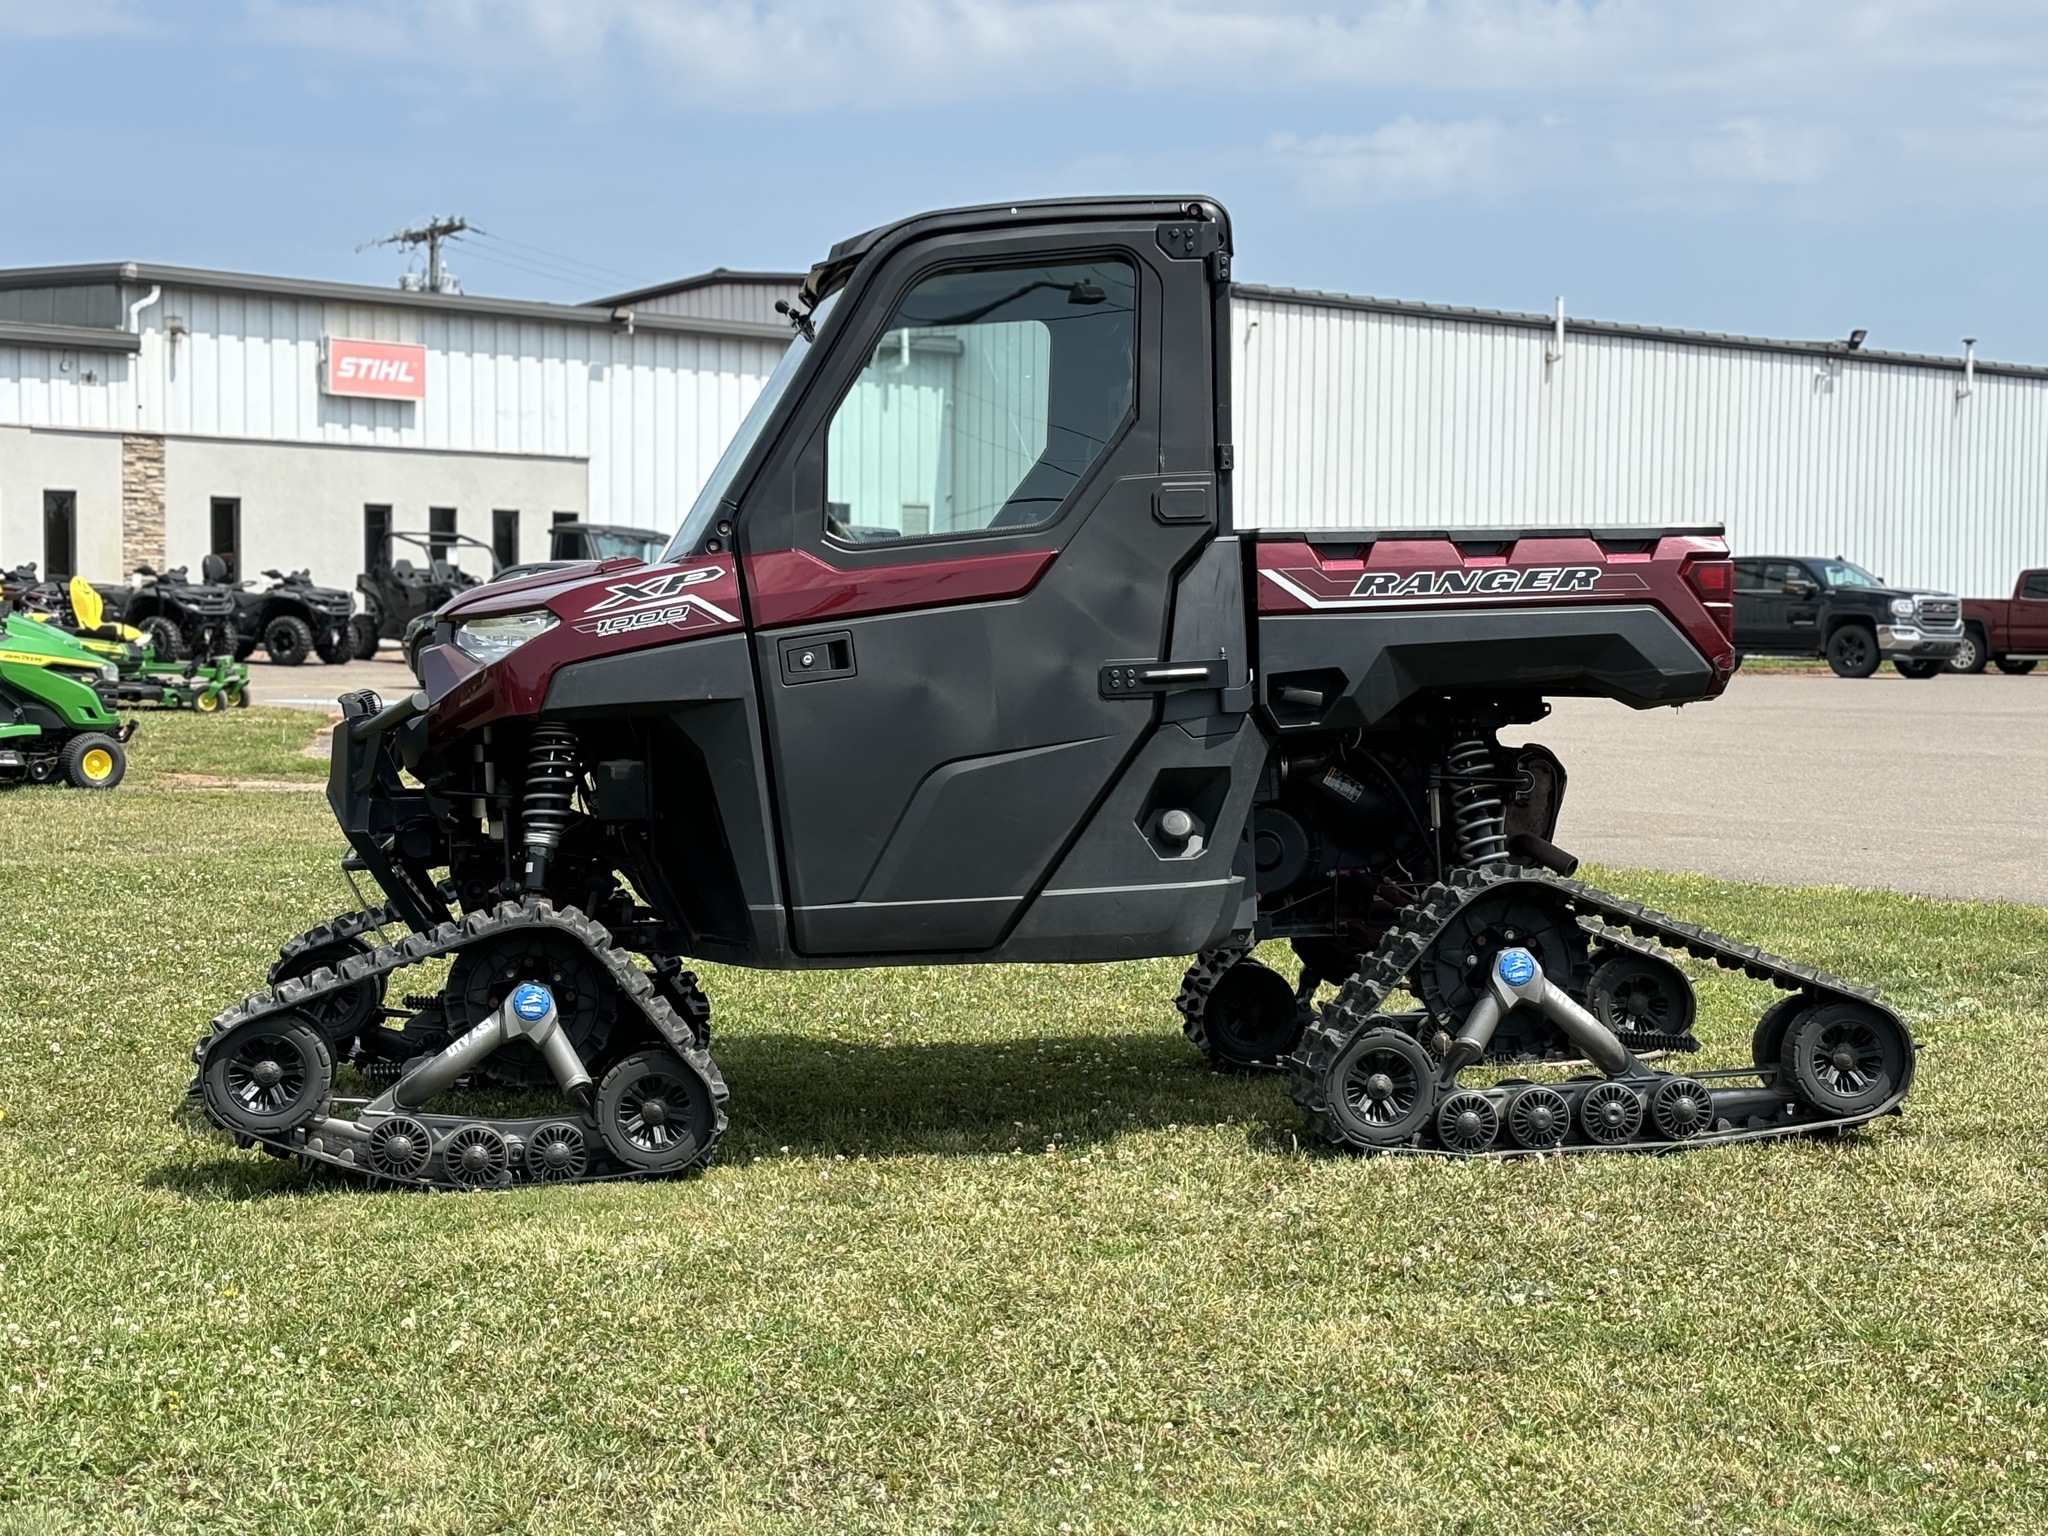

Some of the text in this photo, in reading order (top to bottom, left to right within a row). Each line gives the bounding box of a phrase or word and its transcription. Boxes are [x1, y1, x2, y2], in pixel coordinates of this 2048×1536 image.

[337, 356, 415, 383] STIHL
[584, 566, 726, 613] XP
[1350, 566, 1602, 597] RANGER
[596, 604, 690, 633] 1000
[446, 1033, 470, 1057] UTV
